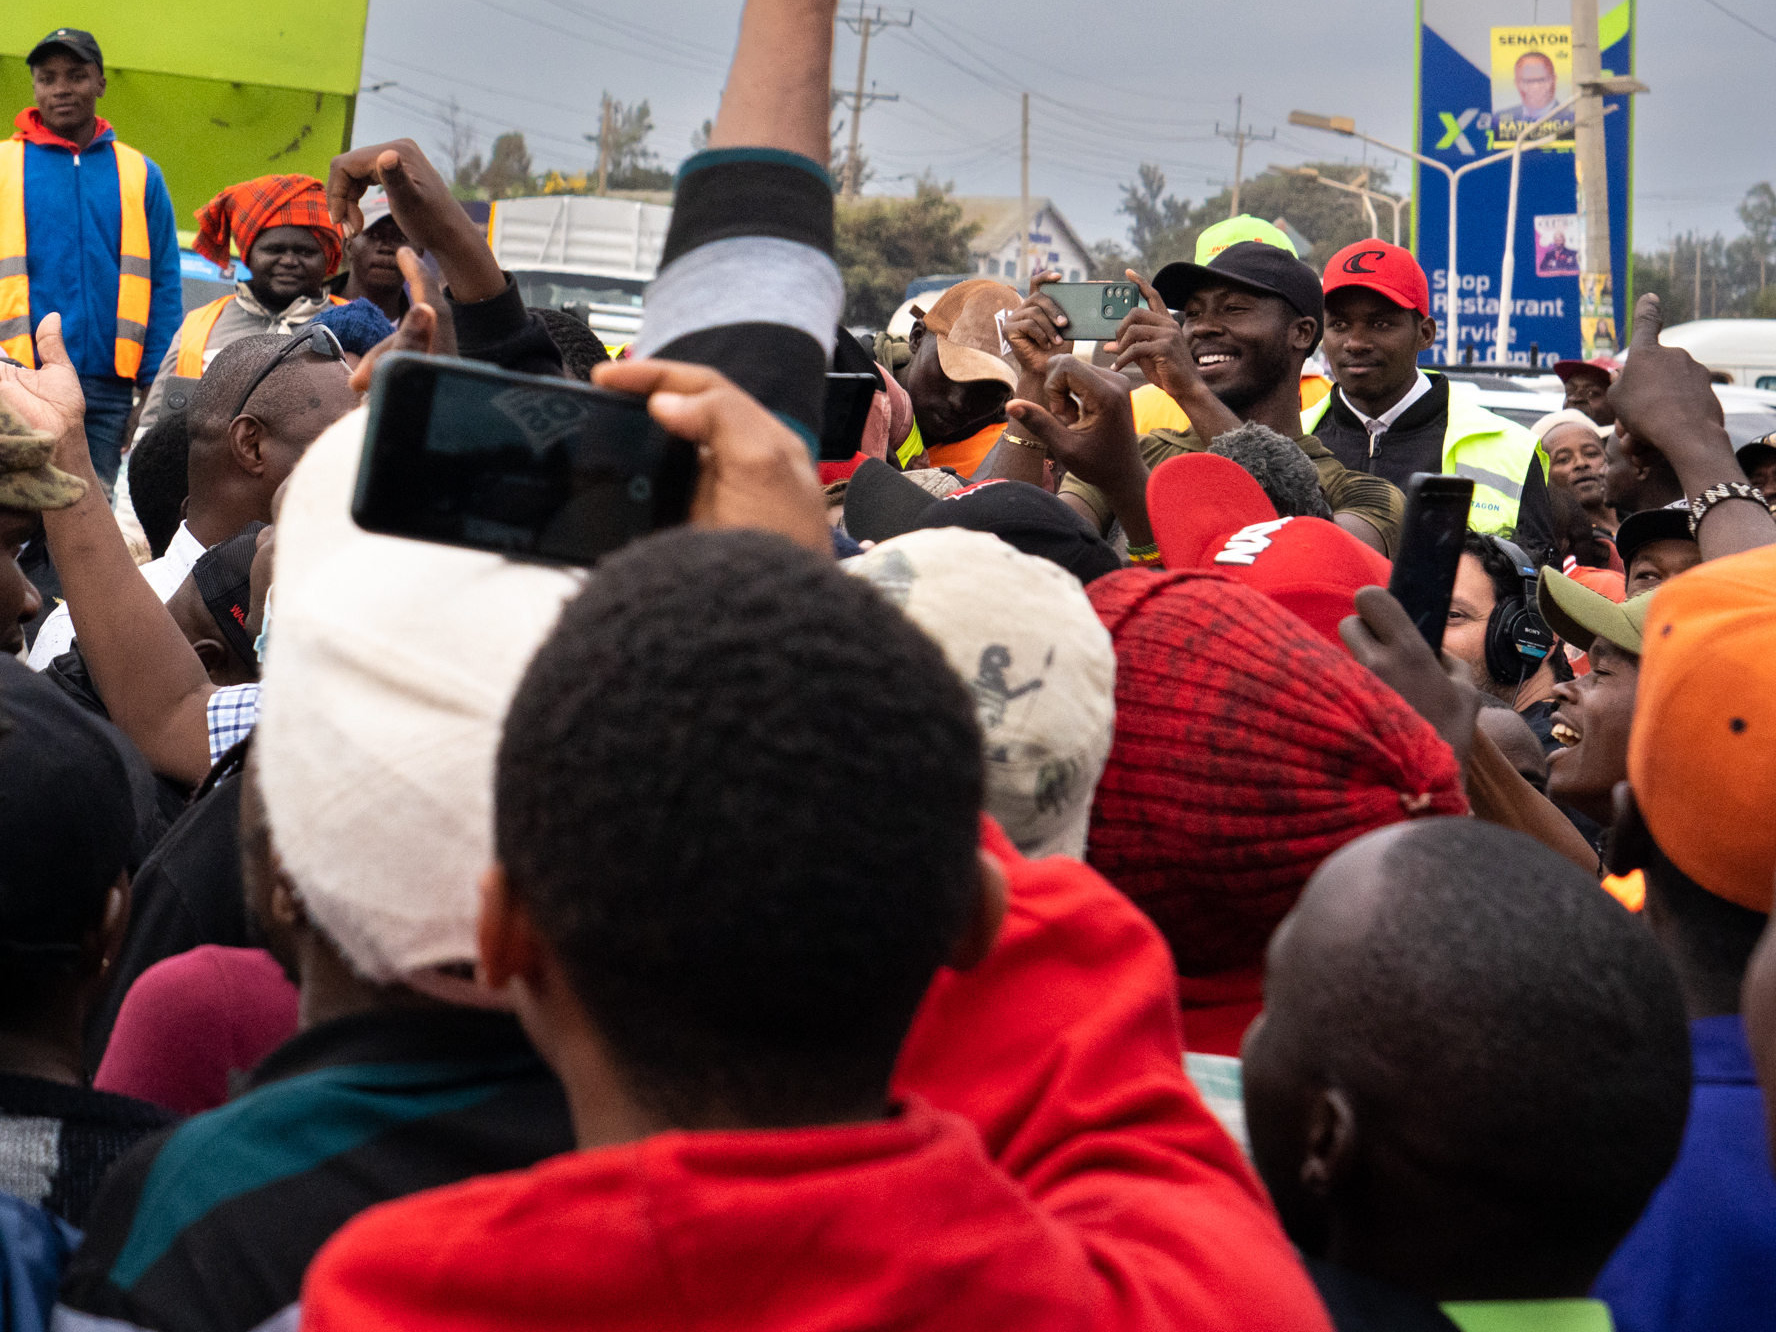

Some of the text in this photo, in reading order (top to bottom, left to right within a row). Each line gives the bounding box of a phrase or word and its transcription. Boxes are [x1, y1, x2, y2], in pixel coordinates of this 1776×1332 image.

[1499, 33, 1569, 46] SENATOR
[1433, 292, 1564, 318] Rstarant
[1524, 628, 1541, 636] SONY
